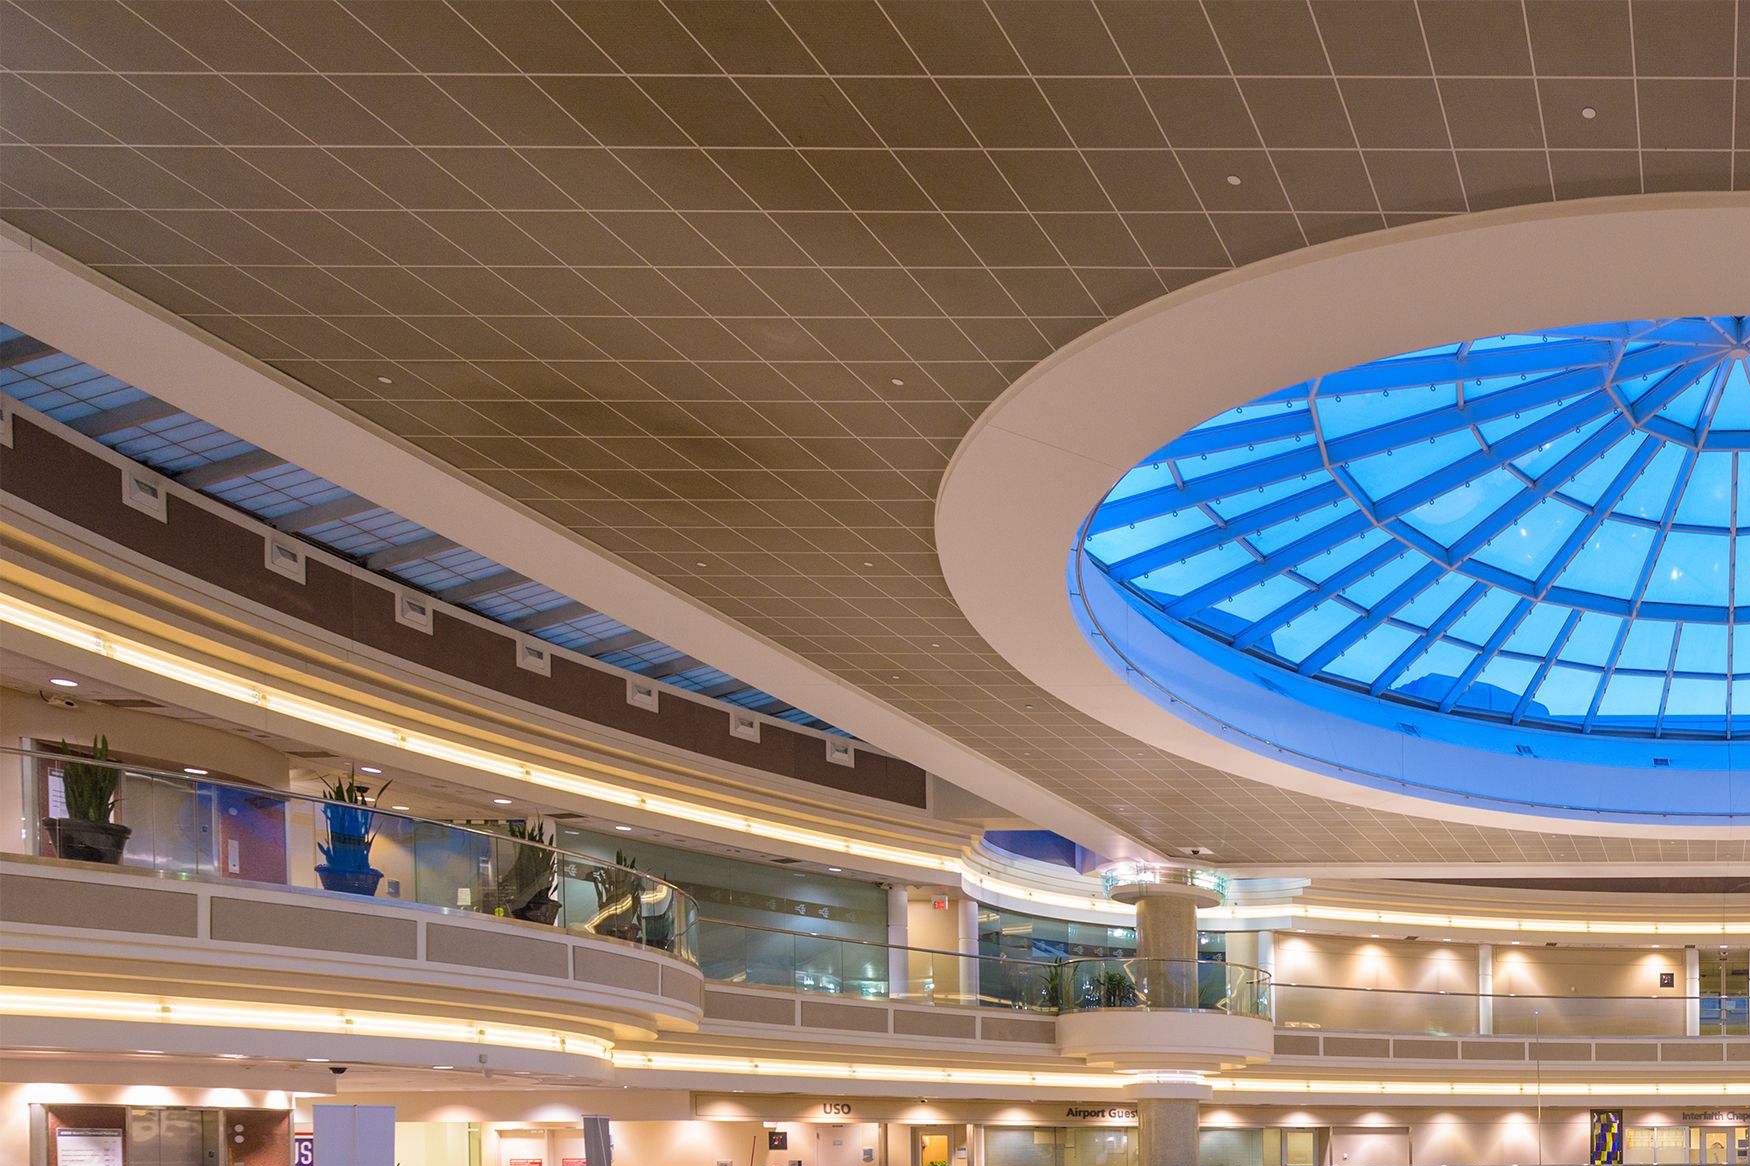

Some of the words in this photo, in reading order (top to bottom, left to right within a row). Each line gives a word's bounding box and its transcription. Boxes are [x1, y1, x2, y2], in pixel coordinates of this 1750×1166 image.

[823, 1103, 851, 1115] USO
[1066, 1107, 1105, 1119] Airport
[1682, 1111, 1724, 1121] Interfaith
